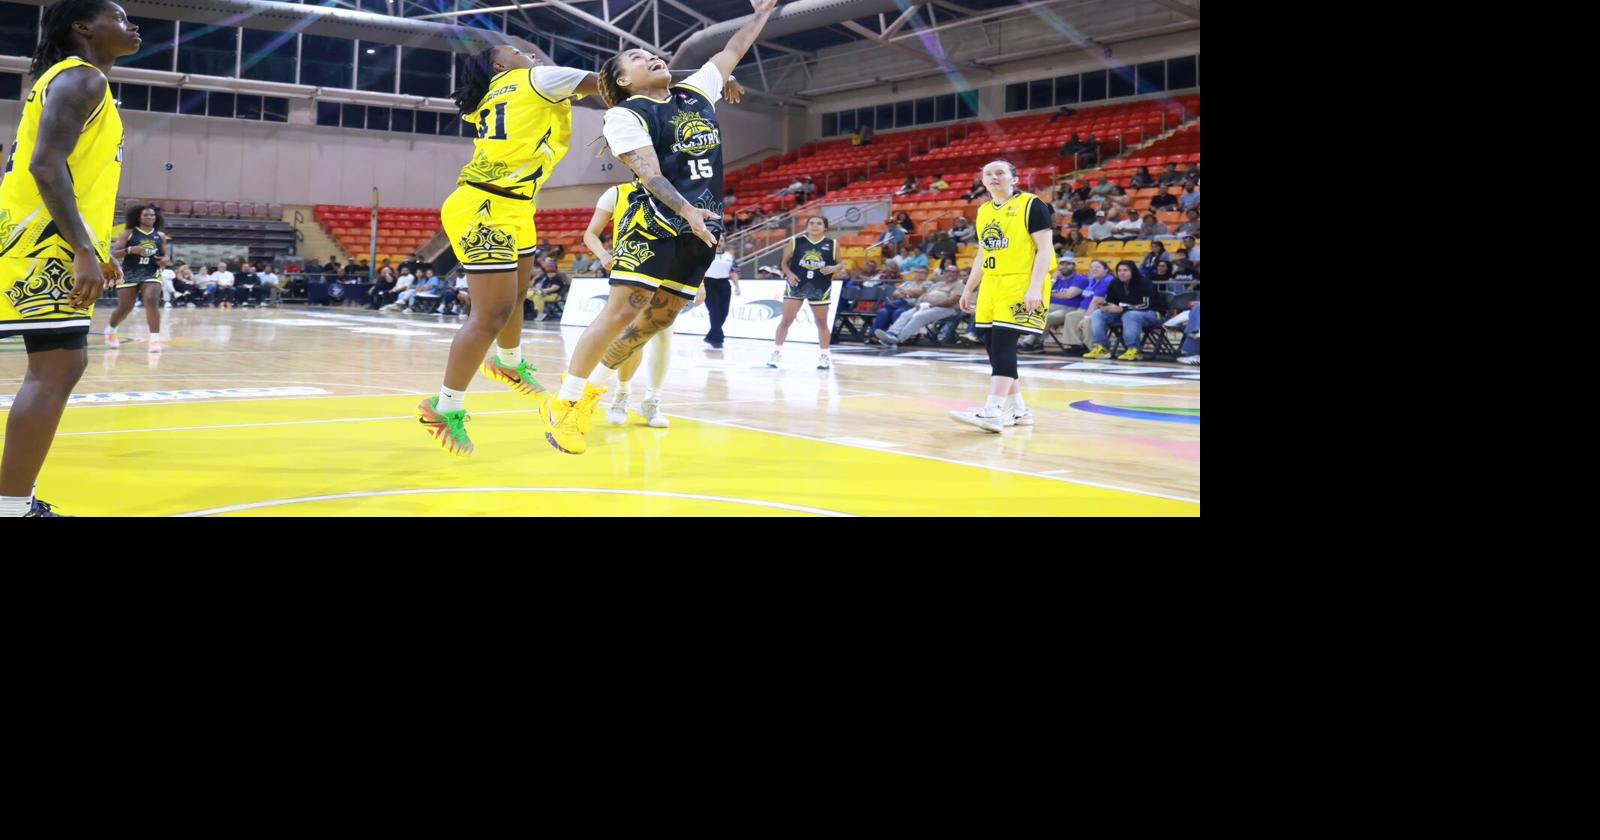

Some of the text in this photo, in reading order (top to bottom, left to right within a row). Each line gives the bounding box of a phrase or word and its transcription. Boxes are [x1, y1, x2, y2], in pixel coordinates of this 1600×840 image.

[692, 128, 721, 147] STAR
[165, 162, 173, 171] 9
[600, 162, 613, 171] 10
[687, 158, 714, 180] 15
[138, 256, 150, 265] 10
[983, 256, 996, 270] 30
[806, 270, 815, 279] 8
[731, 306, 763, 321] VILLA
